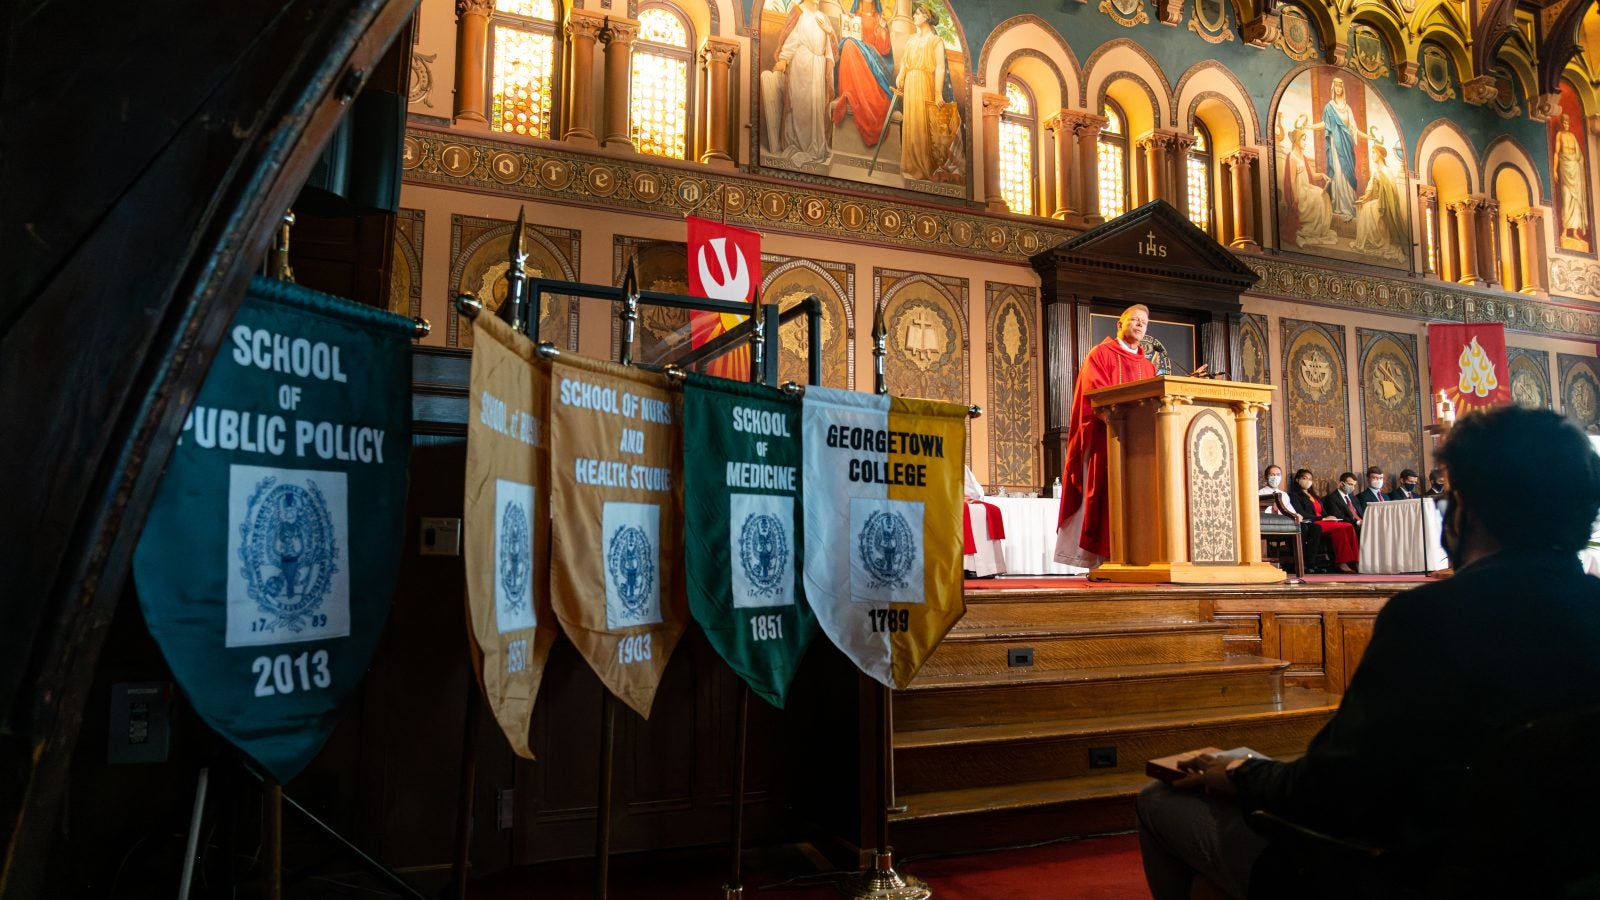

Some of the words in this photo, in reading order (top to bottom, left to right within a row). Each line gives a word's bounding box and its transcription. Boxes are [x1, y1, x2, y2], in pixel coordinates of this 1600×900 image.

[1138, 241, 1168, 258] IHS
[231, 325, 348, 384] SCHOOL
[279, 384, 302, 411] OF
[560, 378, 619, 414] SCHOOL
[622, 392, 640, 418] OF
[732, 406, 791, 438] SCHOOL
[295, 419, 385, 464] POLICY
[619, 428, 645, 455] AND
[756, 441, 768, 457] OF
[827, 424, 944, 458] GEORGETOWN
[575, 457, 628, 488] HEALTH
[726, 461, 797, 491] MEDICINE
[849, 458, 927, 487] COLLEGE
[750, 614, 784, 642] 1851
[869, 609, 909, 633] 1789
[618, 633, 652, 665] 1903
[252, 650, 332, 698] 2013
